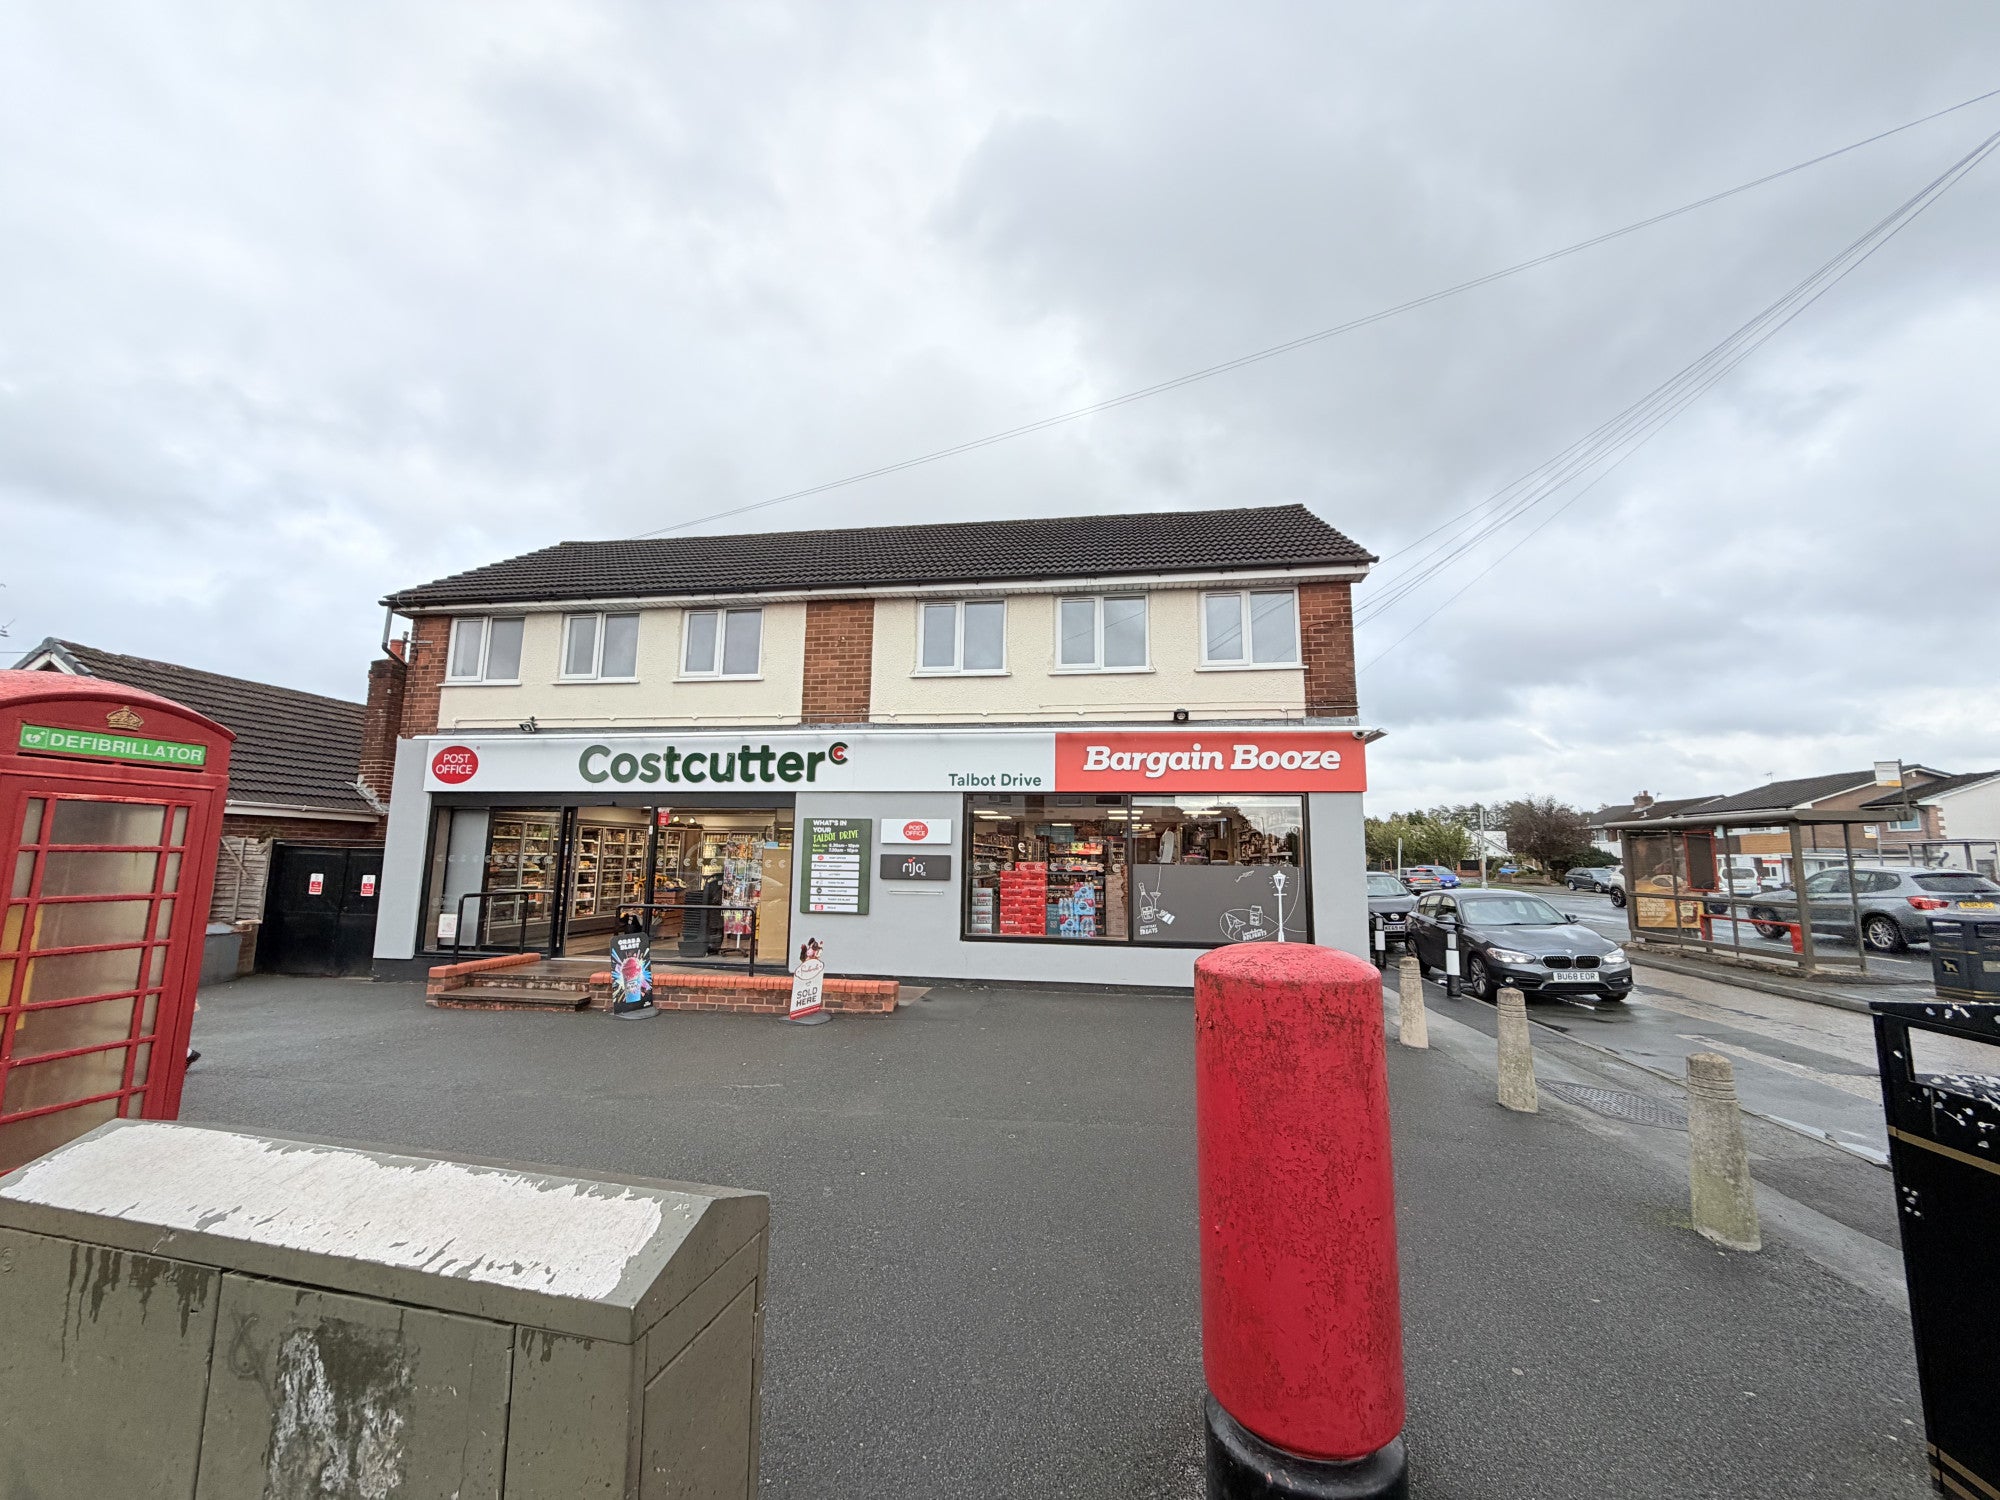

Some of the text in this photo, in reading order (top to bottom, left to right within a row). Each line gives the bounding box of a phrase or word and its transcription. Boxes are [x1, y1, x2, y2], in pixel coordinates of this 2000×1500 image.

[50, 733, 202, 761] DEFIBRILLATOR
[443, 753, 470, 763] POST
[579, 744, 825, 783] Costcutter
[1083, 743, 1341, 778] Bargain Booze
[435, 764, 473, 775] OFFICE
[948, 773, 1042, 786] Talbot Drive
[812, 829, 859, 843] TALBOT DRIVE
[620, 943, 640, 951] BLAST
[797, 986, 818, 999] SOLD
[796, 996, 817, 1007] HERE
